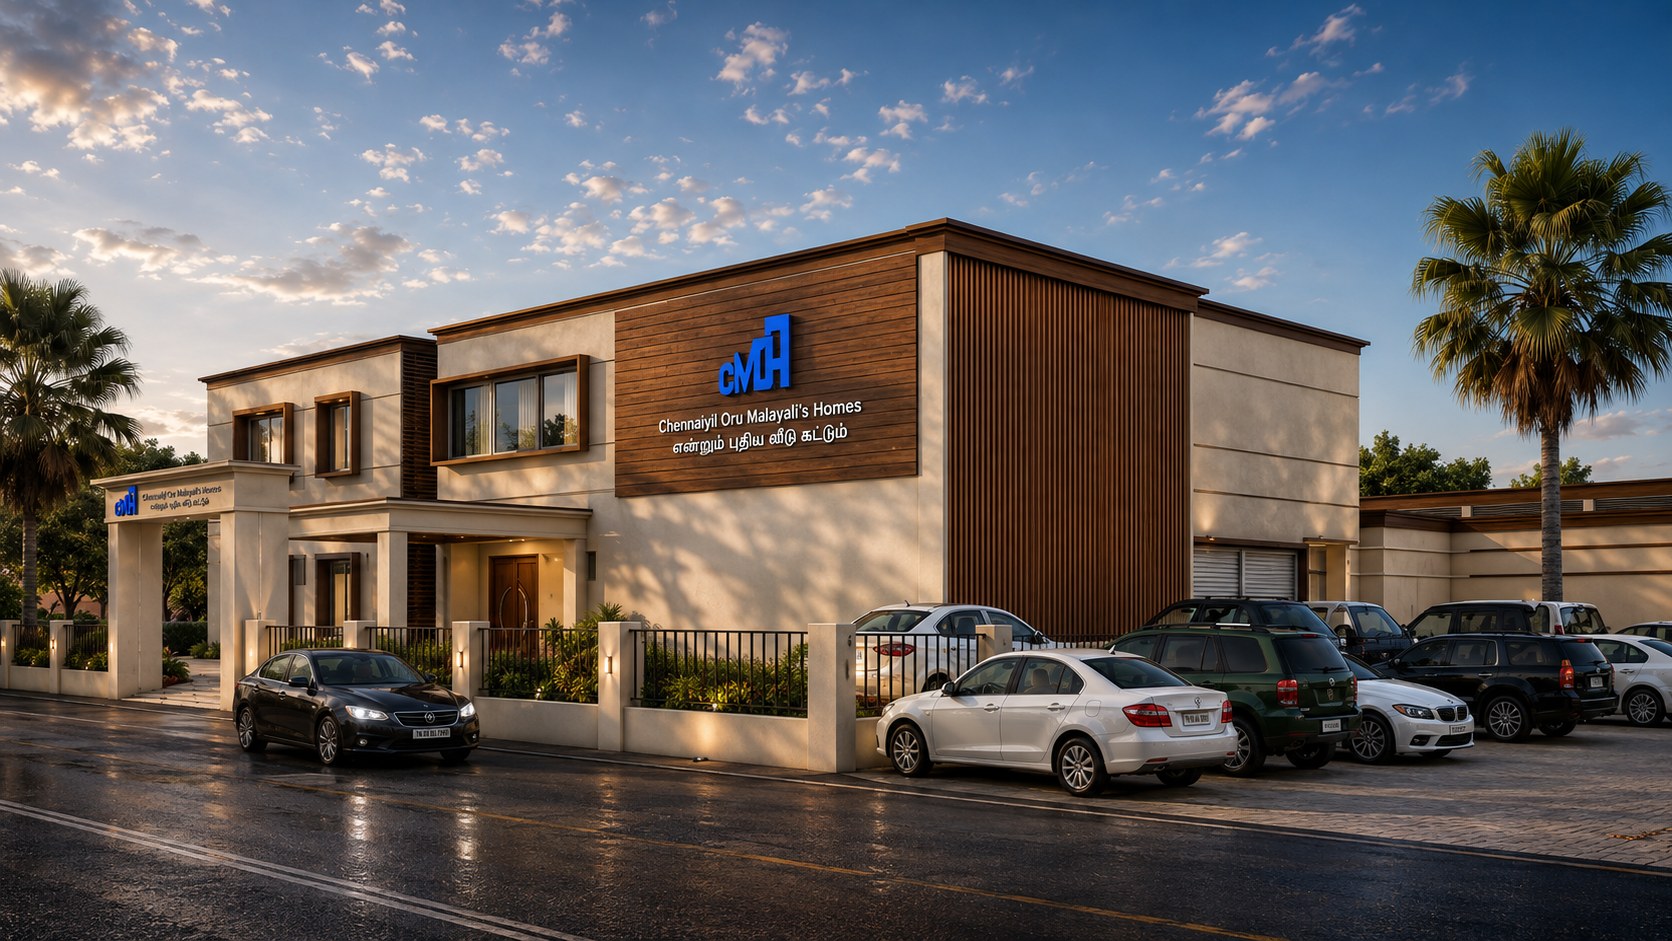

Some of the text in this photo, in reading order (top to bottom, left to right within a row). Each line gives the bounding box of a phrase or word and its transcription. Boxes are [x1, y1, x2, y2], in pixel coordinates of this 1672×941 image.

[658, 401, 862, 433] Chennaiyil Oru Malayali's Homes
[673, 422, 848, 456] என்றும் புதிய வீடு கட்டும்
